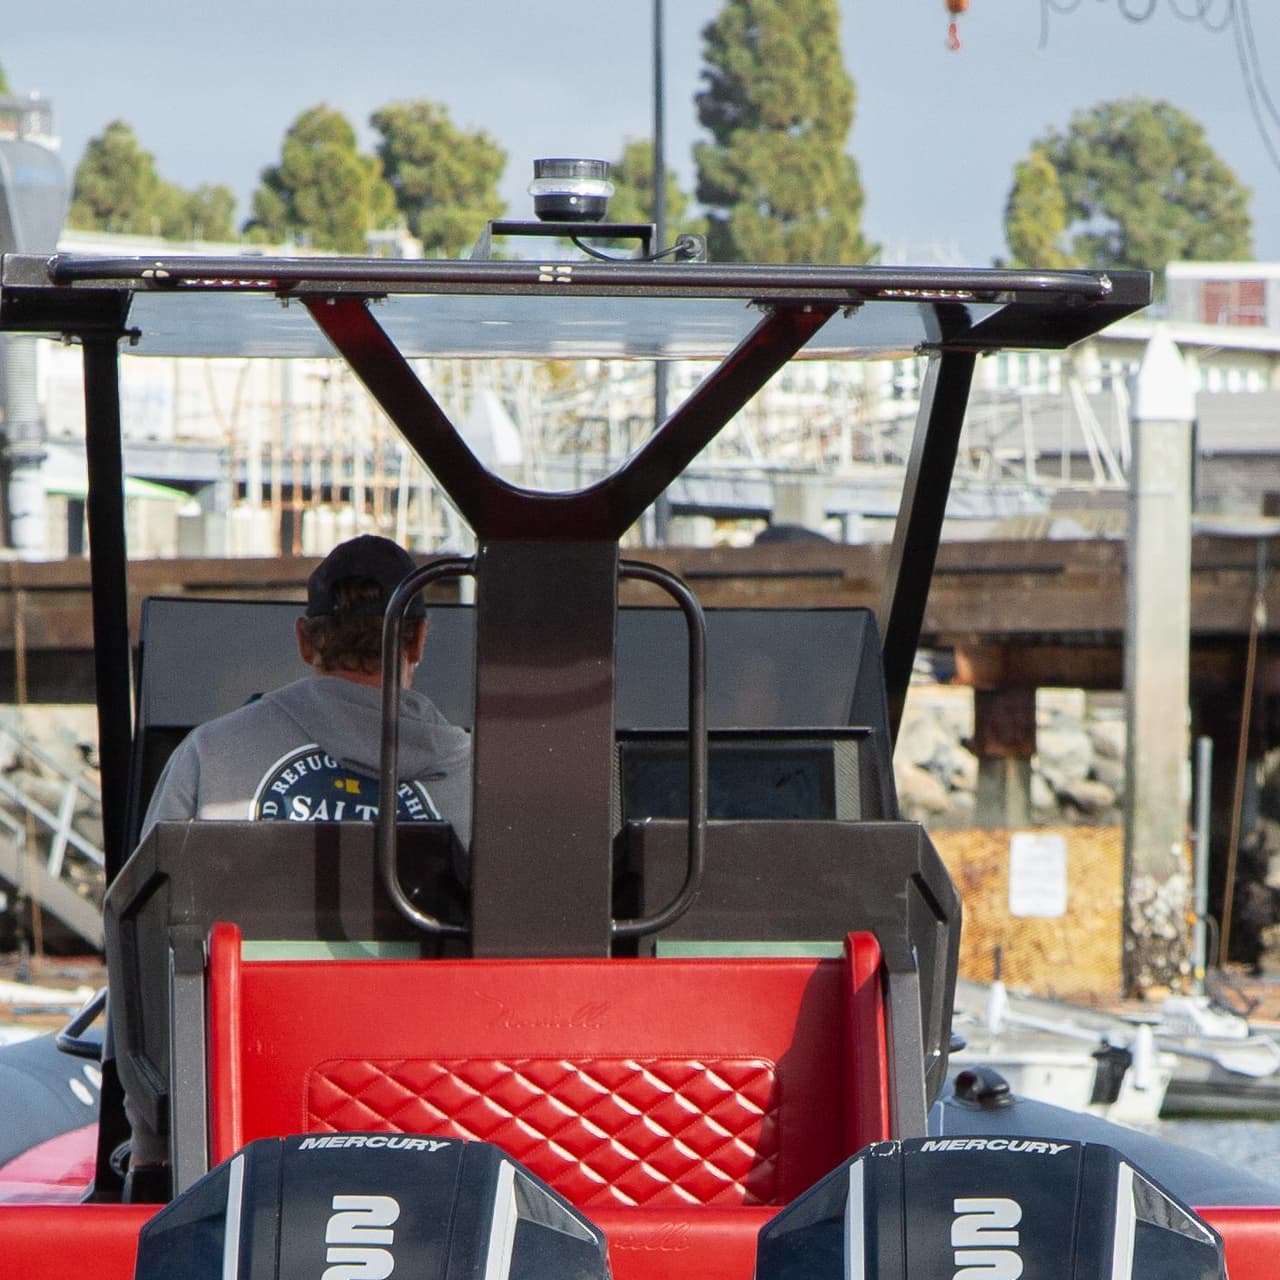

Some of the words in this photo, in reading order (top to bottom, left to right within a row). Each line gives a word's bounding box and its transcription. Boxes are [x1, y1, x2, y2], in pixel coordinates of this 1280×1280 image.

[271, 754, 338, 795] REFUG
[298, 1136, 452, 1152] MERCURY
[920, 1138, 1072, 1155] MERCURY
